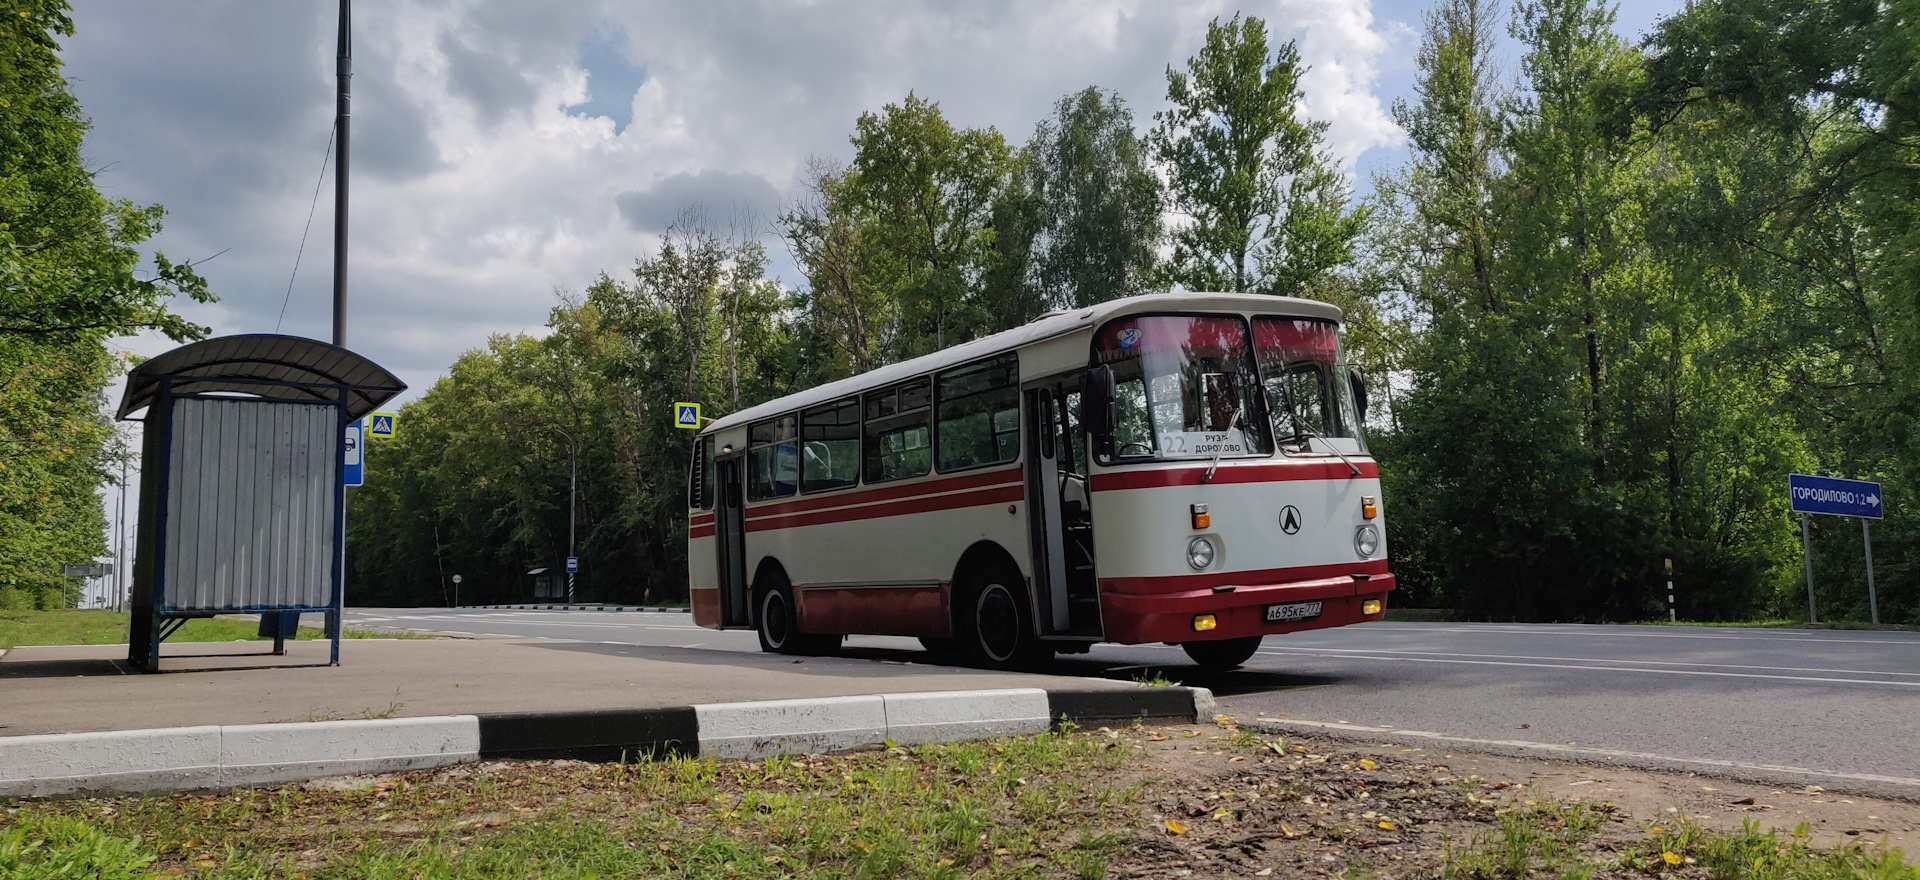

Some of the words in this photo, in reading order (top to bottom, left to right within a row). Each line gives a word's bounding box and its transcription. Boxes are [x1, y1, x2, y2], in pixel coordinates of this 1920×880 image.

[1164, 436, 1186, 453] 22
[1793, 486, 1854, 504] ГОРОДИЛОВО
[1855, 493, 1866, 506] 1,2
[1269, 606, 1304, 619] А695КЕ
